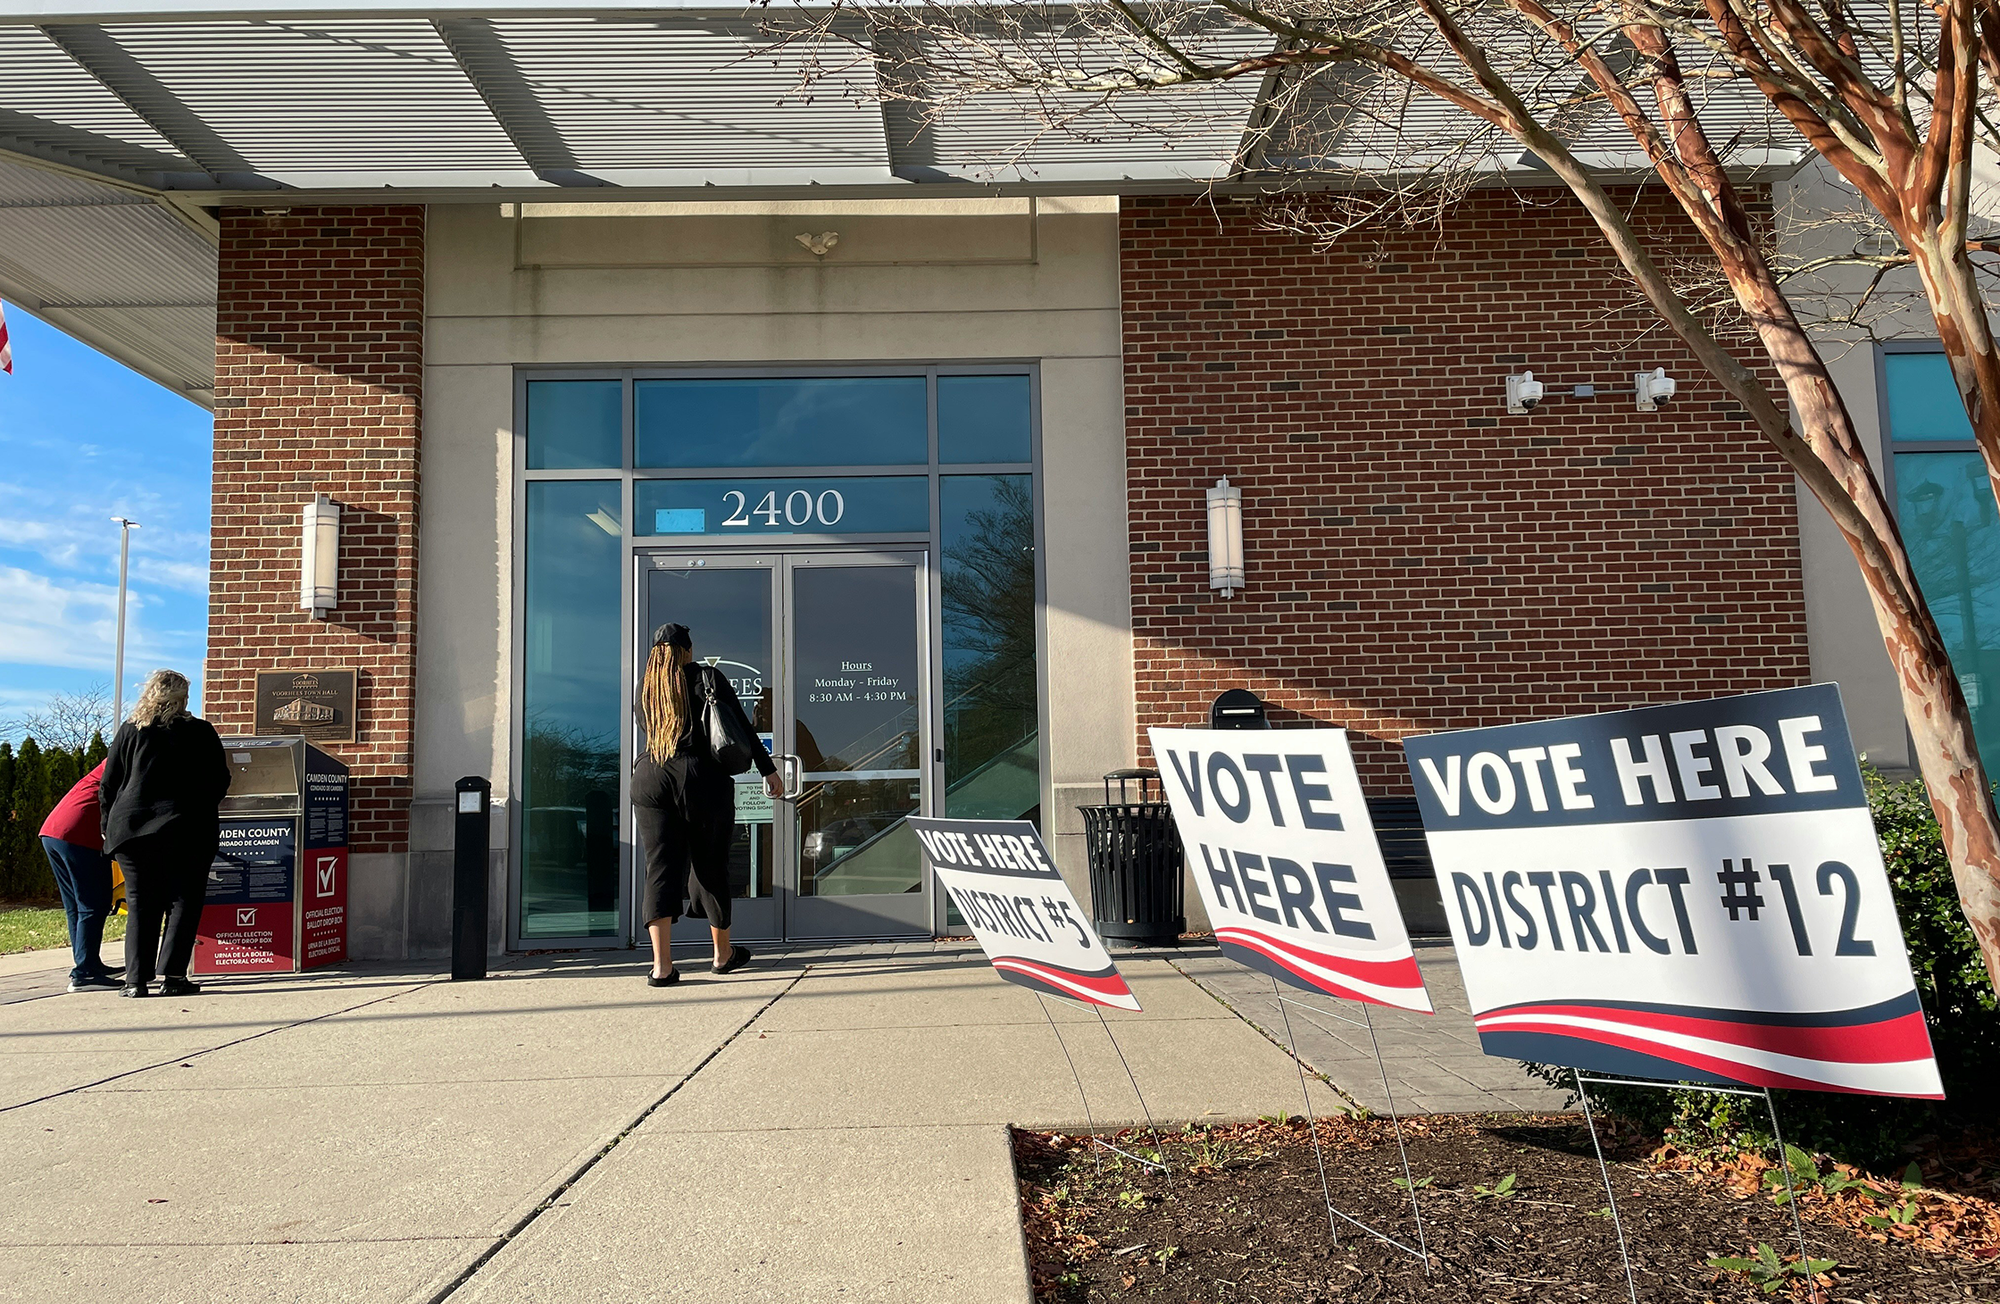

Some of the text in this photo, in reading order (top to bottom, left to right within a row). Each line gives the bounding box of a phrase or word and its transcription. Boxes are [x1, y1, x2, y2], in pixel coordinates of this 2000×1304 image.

[721, 489, 844, 526] 2400
[815, 677, 856, 689] Monday
[867, 676, 899, 688] Friday
[841, 661, 872, 670] Hours
[809, 693, 832, 702] 8:30
[835, 692, 853, 702] AM
[863, 692, 887, 701] 4:30
[890, 691, 906, 700] PM
[306, 773, 347, 784] CAMDEN COUNTY
[1418, 715, 1838, 817] VOTE HERE
[1166, 749, 1345, 832] VOTE
[219, 827, 291, 839] MDEN COUNTY
[915, 828, 1051, 872] VOTE HERE
[1199, 842, 1377, 941] HERE
[1450, 857, 1878, 957] DISTRICT #12
[951, 886, 1091, 949] DISTRICT #5
